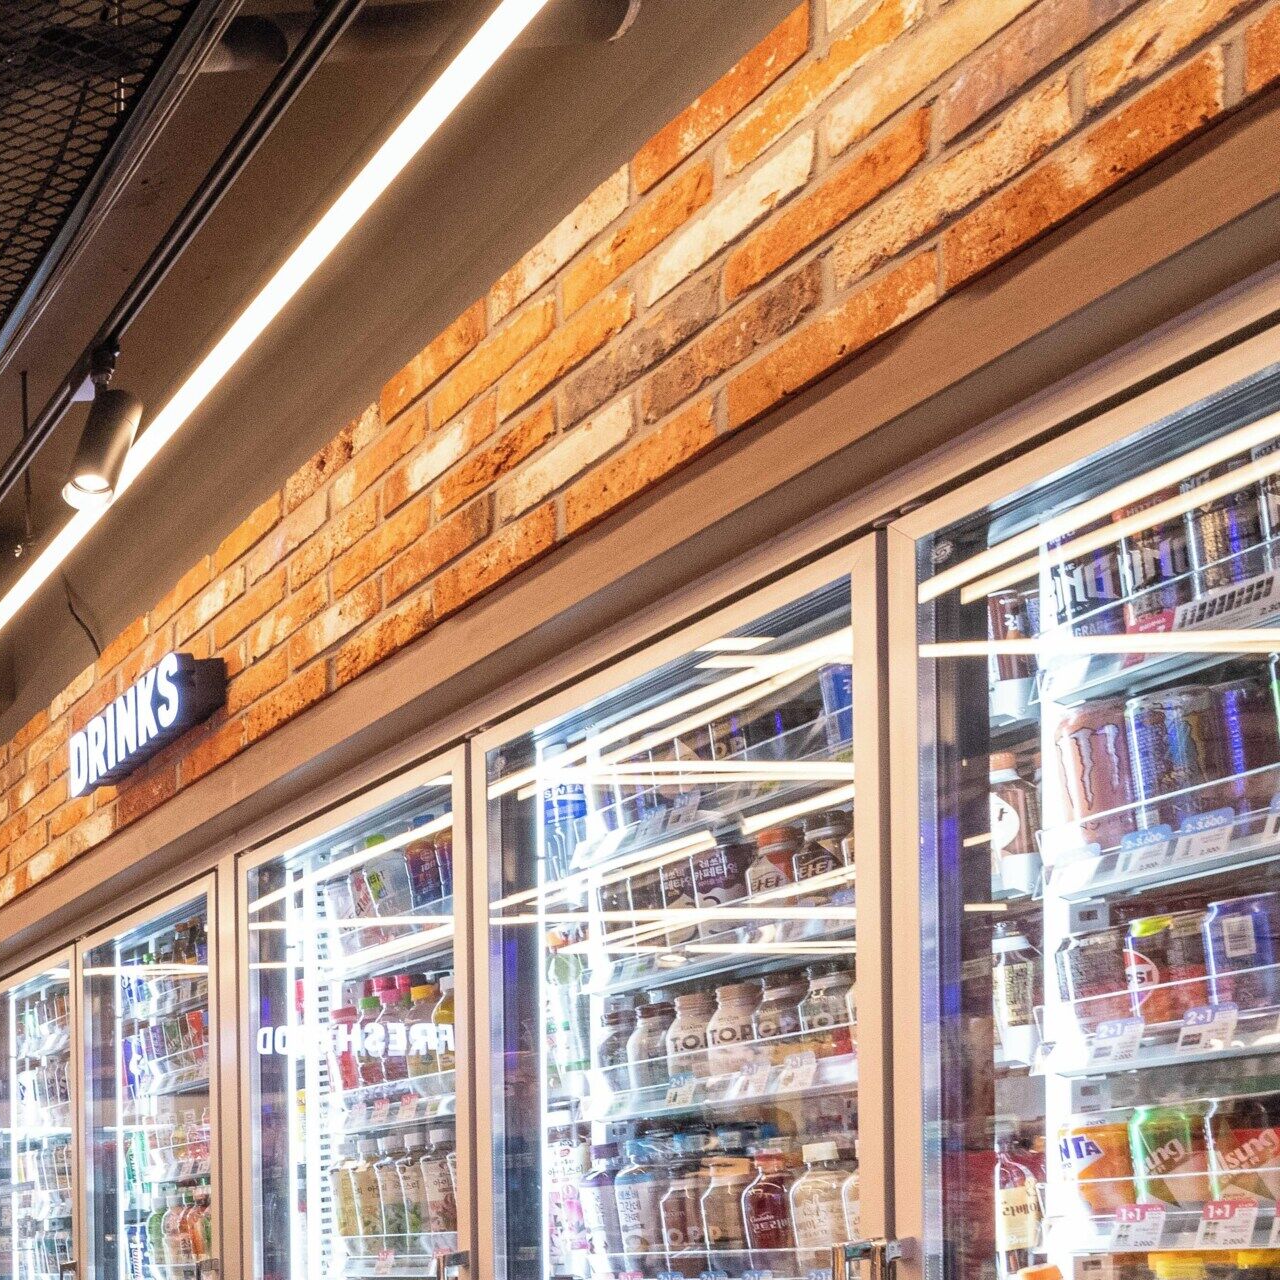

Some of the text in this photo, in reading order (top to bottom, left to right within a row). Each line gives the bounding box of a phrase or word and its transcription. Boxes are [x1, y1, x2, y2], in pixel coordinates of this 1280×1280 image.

[69, 652, 179, 798] DRINKS
[543, 784, 584, 799] SWEA
[1118, 1205, 1142, 1222] 1+1
[1205, 1203, 1231, 1219] 1+1
